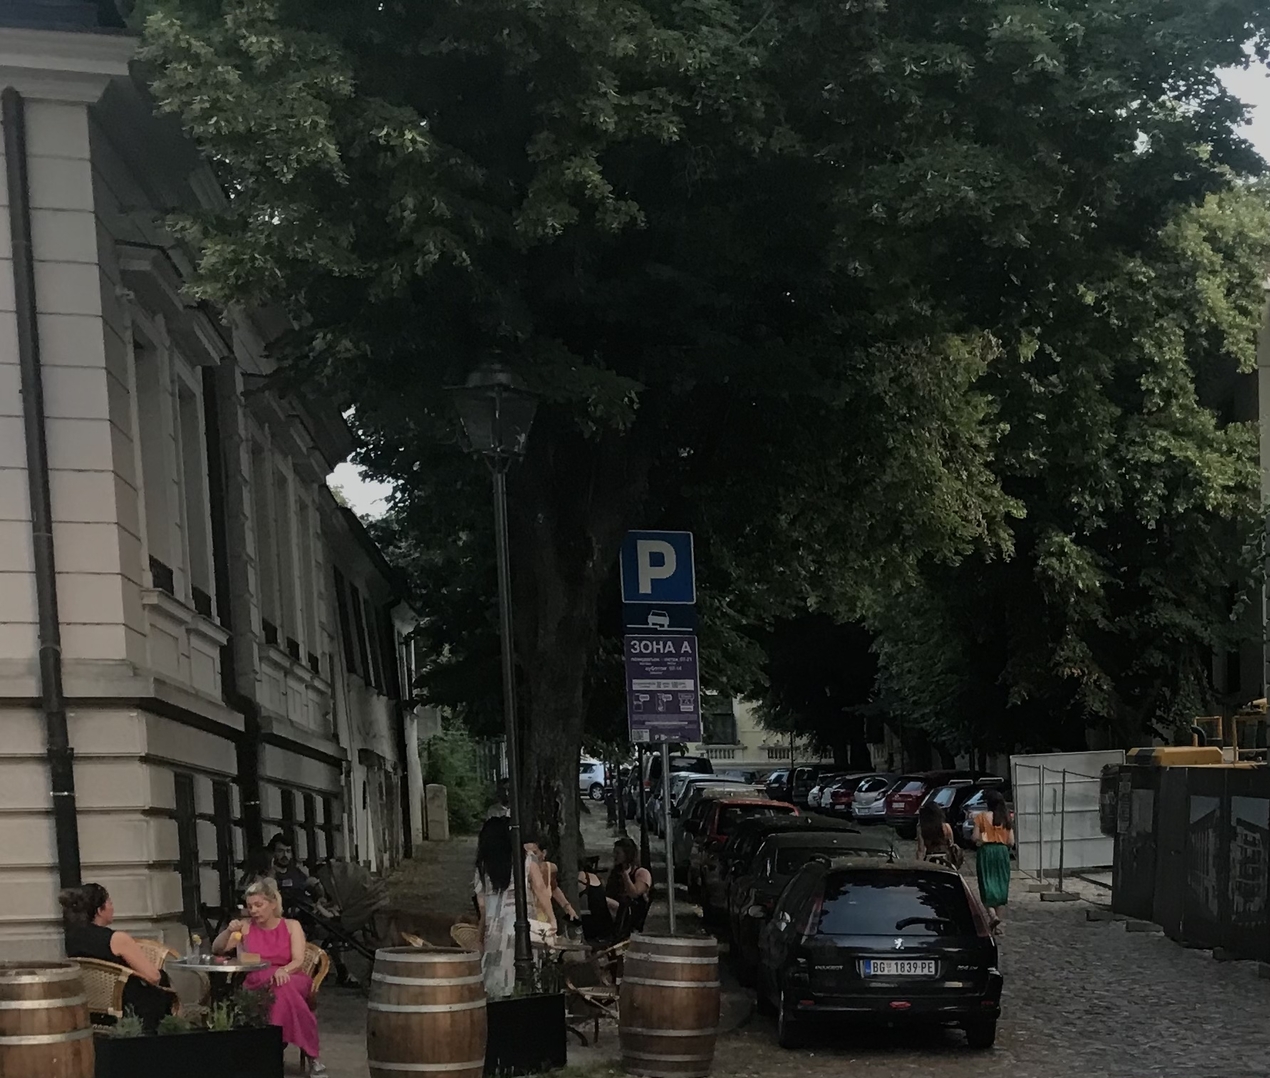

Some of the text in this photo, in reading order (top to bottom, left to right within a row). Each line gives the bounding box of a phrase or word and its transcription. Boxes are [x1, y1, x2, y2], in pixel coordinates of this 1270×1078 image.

[637, 540, 676, 594] P
[630, 640, 692, 654] ЗОНА А
[872, 961, 885, 973] BG
